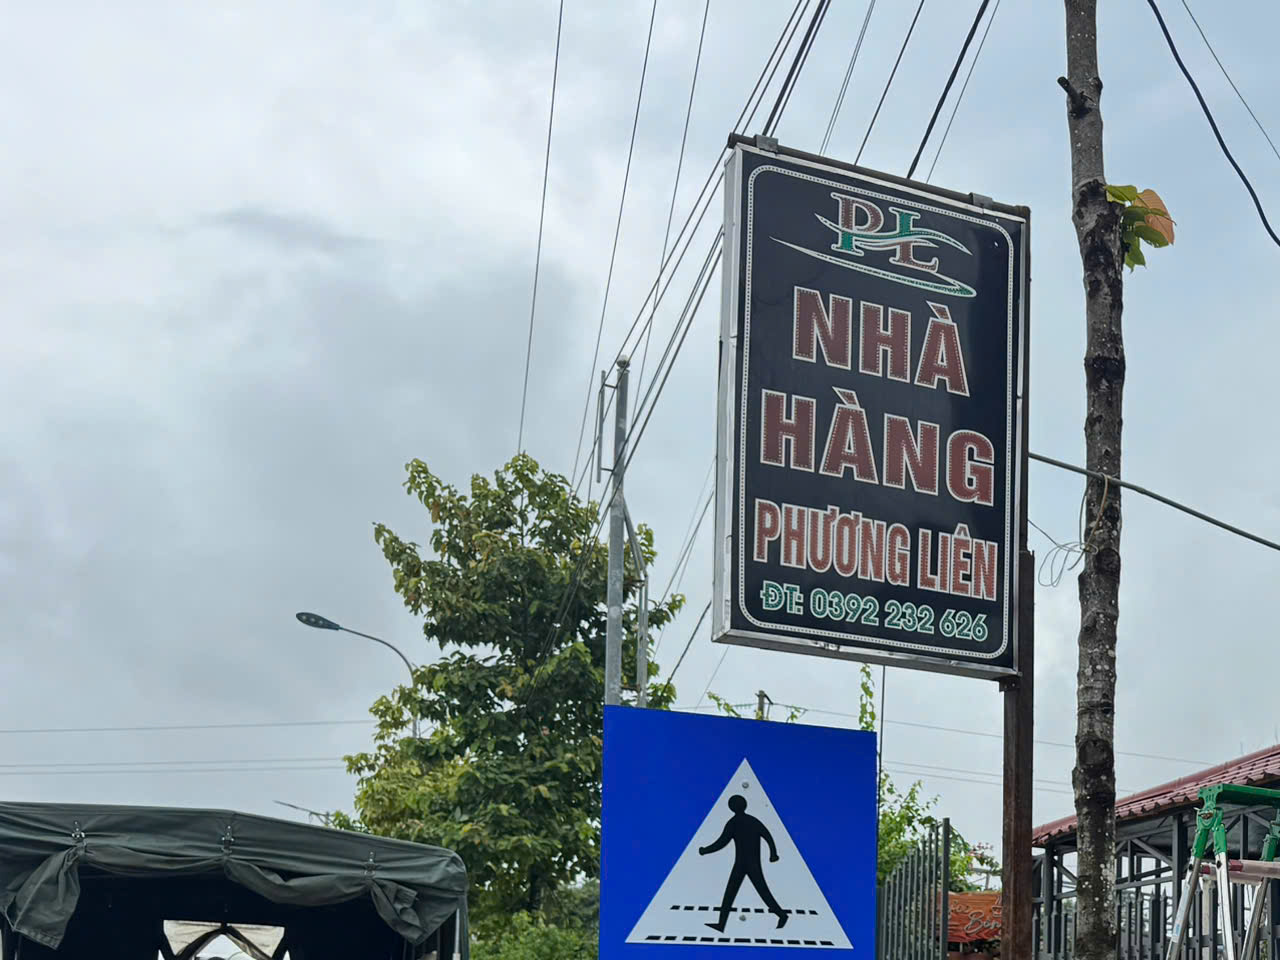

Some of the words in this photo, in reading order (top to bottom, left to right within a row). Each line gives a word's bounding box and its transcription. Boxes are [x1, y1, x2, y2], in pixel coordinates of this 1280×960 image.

[793, 286, 970, 397] NHÀ
[760, 386, 995, 507] HÀNG
[753, 498, 911, 587] PHƯƠNG
[917, 522, 998, 601] LIÊN
[760, 580, 804, 615] ĐT:
[810, 588, 879, 626] 0392
[884, 600, 934, 634] 232
[939, 609, 988, 641] 626
